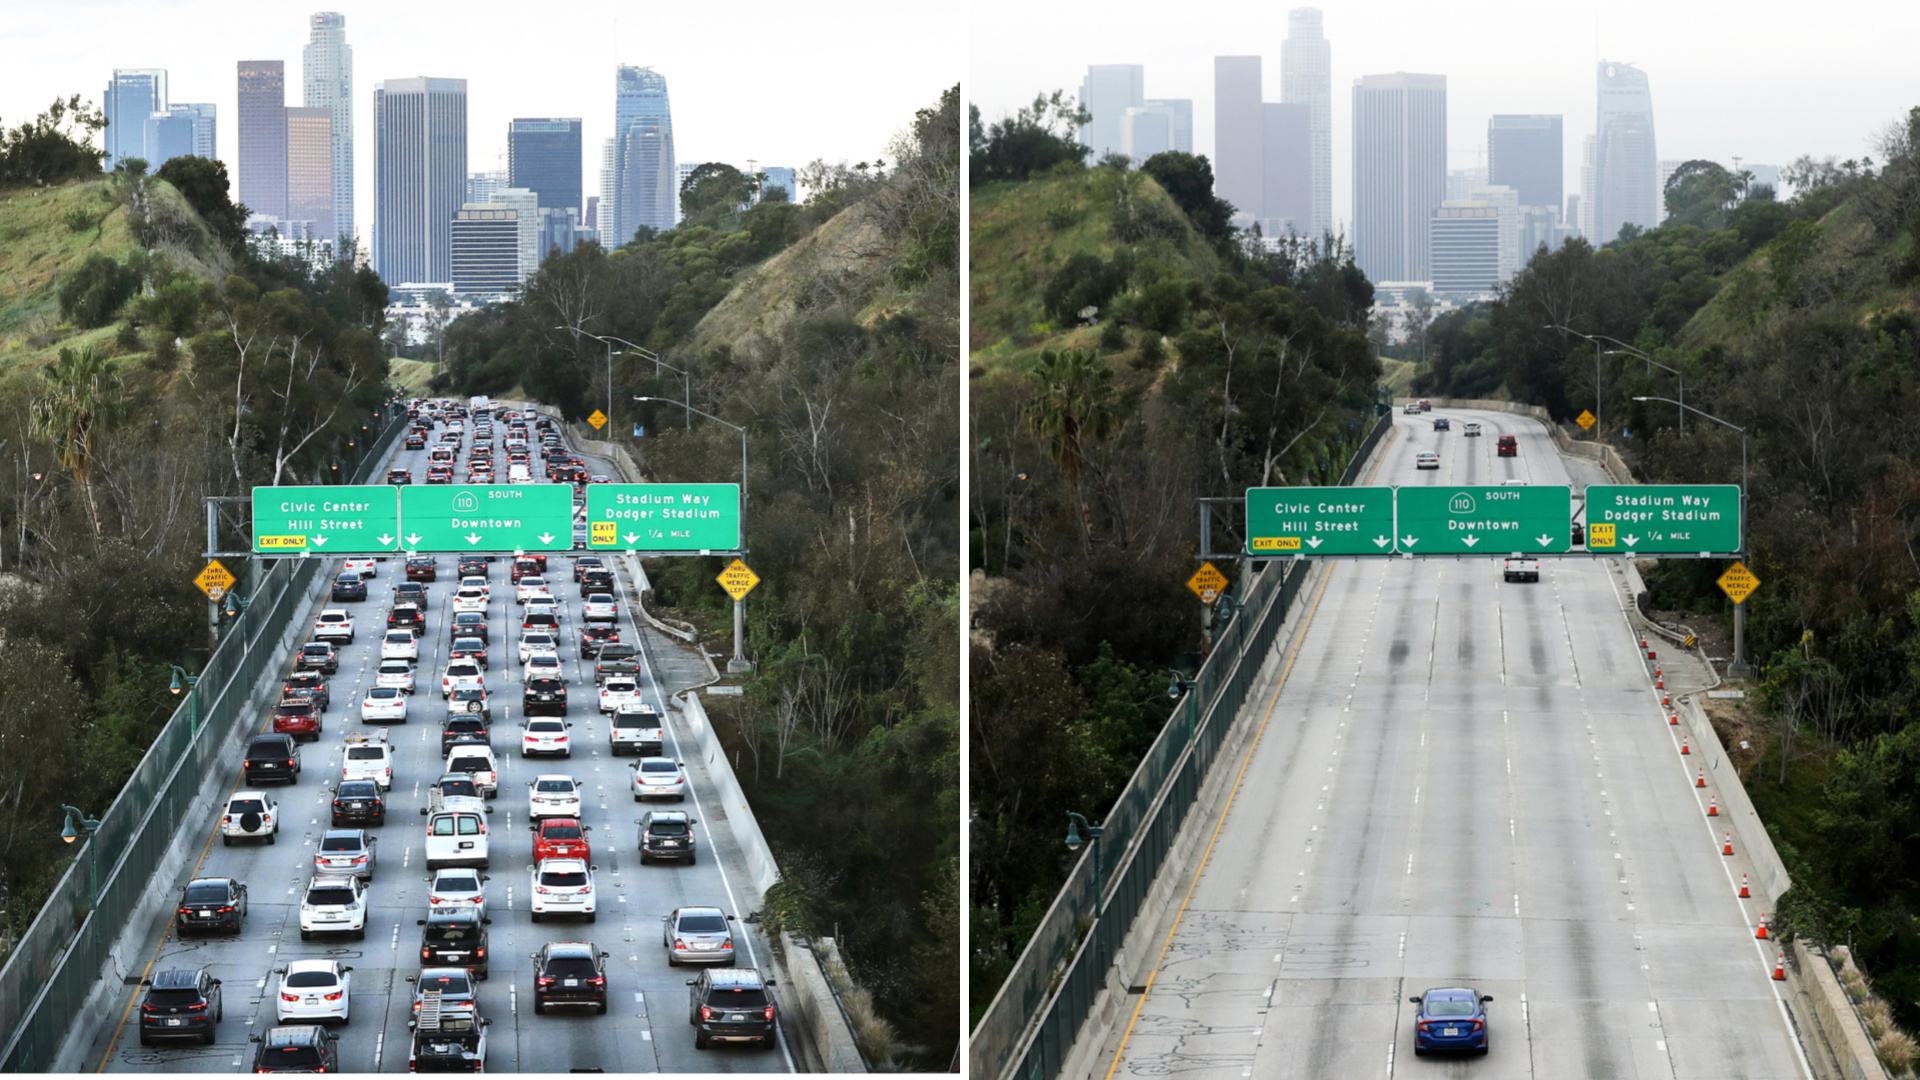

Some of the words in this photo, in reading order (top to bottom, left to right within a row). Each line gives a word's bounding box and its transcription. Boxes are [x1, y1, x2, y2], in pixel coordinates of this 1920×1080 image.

[488, 490, 522, 498] SOUTH
[1486, 492, 1520, 500] SOUTH
[458, 498, 472, 508] 110
[616, 494, 674, 504] Stadium
[682, 494, 710, 506] Way
[1454, 499, 1470, 509] 110
[1616, 495, 1674, 506] Stadium
[1682, 495, 1710, 508] Way
[281, 502, 316, 512] Civic
[323, 502, 370, 512] Center
[1275, 503, 1310, 514] Civic
[1318, 502, 1365, 513] Center
[606, 508, 654, 521] Dodger
[662, 508, 720, 518] Stadium
[1605, 510, 1654, 523] Dodger
[1662, 510, 1720, 520] Stadium
[288, 520, 312, 530] Hill
[320, 520, 363, 530] Street
[452, 518, 522, 528] Downtown
[1282, 522, 1308, 532] Hill
[1315, 521, 1358, 532] Street
[1448, 520, 1519, 530] Downtown
